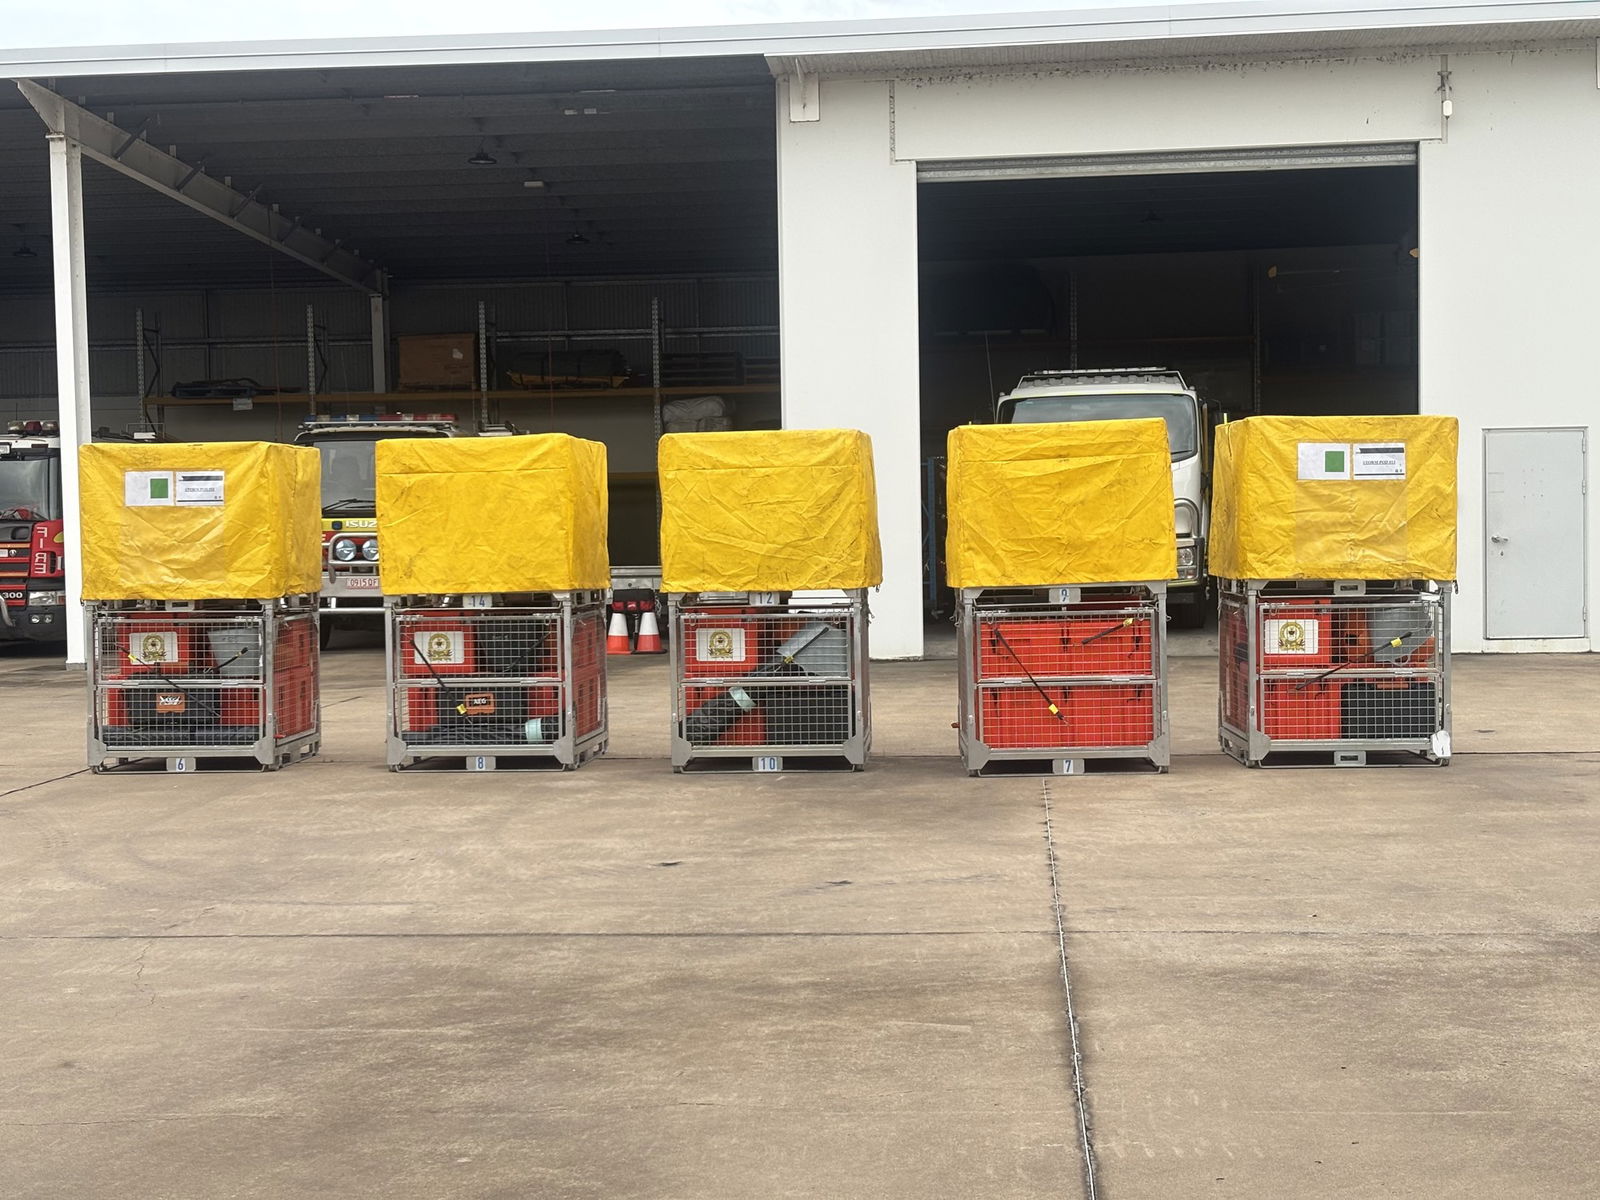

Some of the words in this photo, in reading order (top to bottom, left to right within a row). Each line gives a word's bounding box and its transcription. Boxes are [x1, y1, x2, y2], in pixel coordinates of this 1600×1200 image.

[345, 519, 377, 528] ISUZ
[471, 595, 486, 608] 14
[758, 591, 773, 605] 12
[177, 757, 184, 770] 6
[477, 756, 484, 769] 8
[760, 757, 776, 770] 10
[1065, 759, 1072, 773] 7
